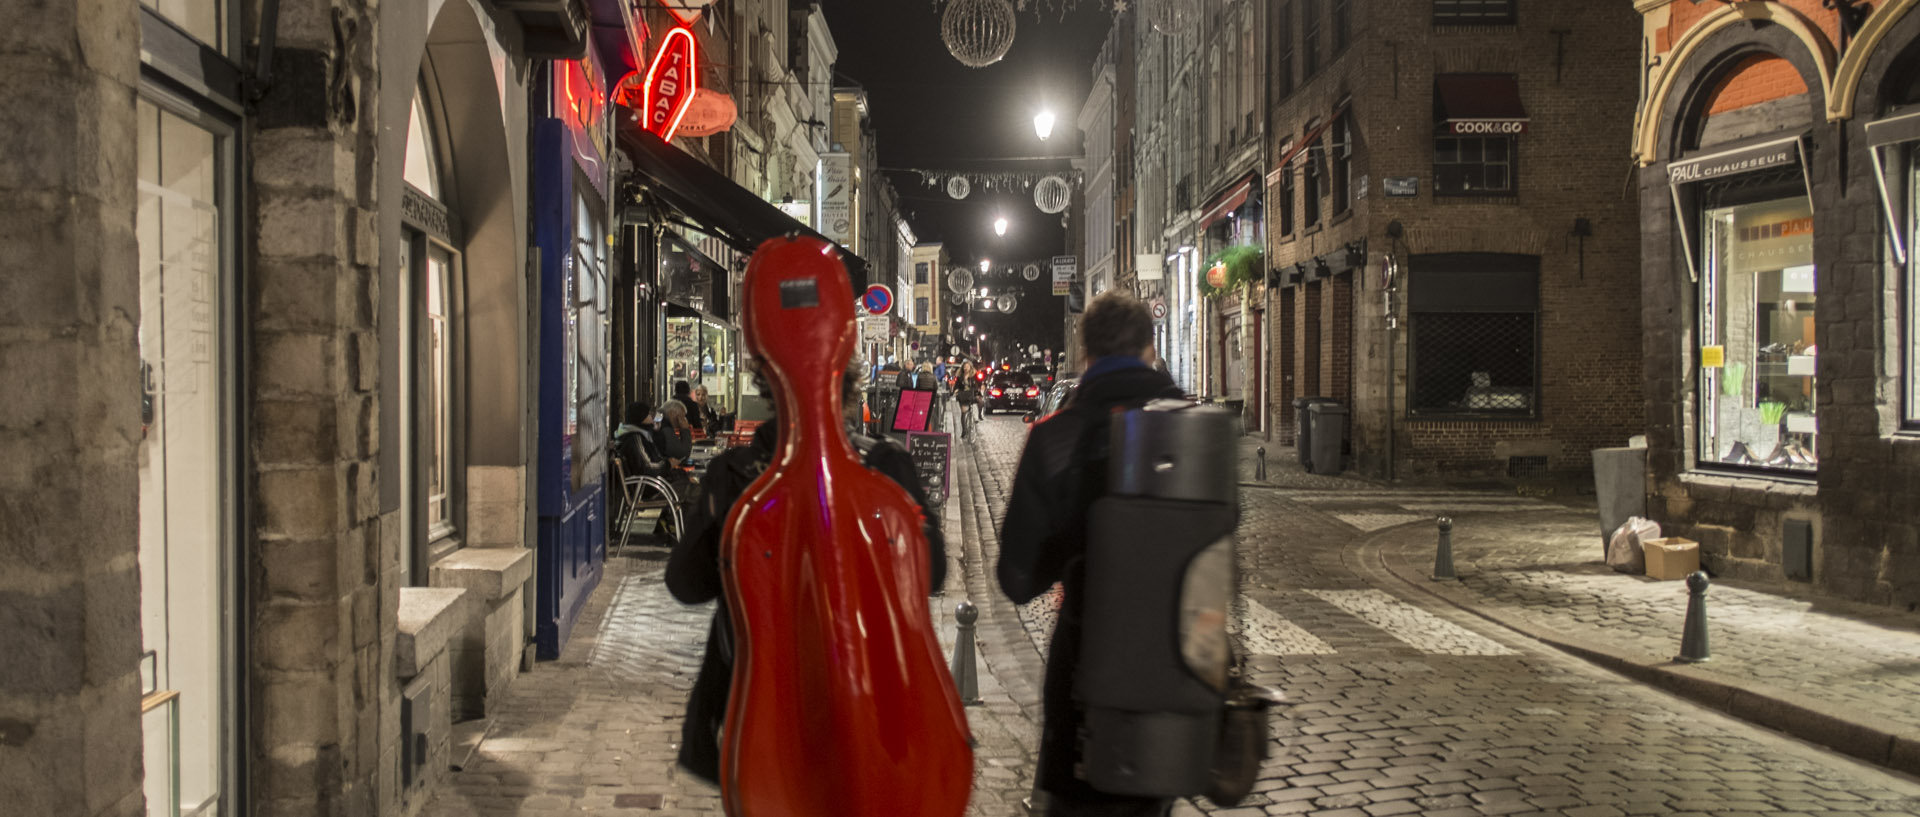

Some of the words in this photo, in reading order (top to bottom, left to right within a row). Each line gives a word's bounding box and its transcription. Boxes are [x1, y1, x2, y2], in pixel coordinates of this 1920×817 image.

[653, 52, 682, 123] TABAC
[1455, 122, 1522, 133] COOK&GO
[1671, 163, 1702, 182] PAUL
[1704, 152, 1787, 176] CHAUSSEUR
